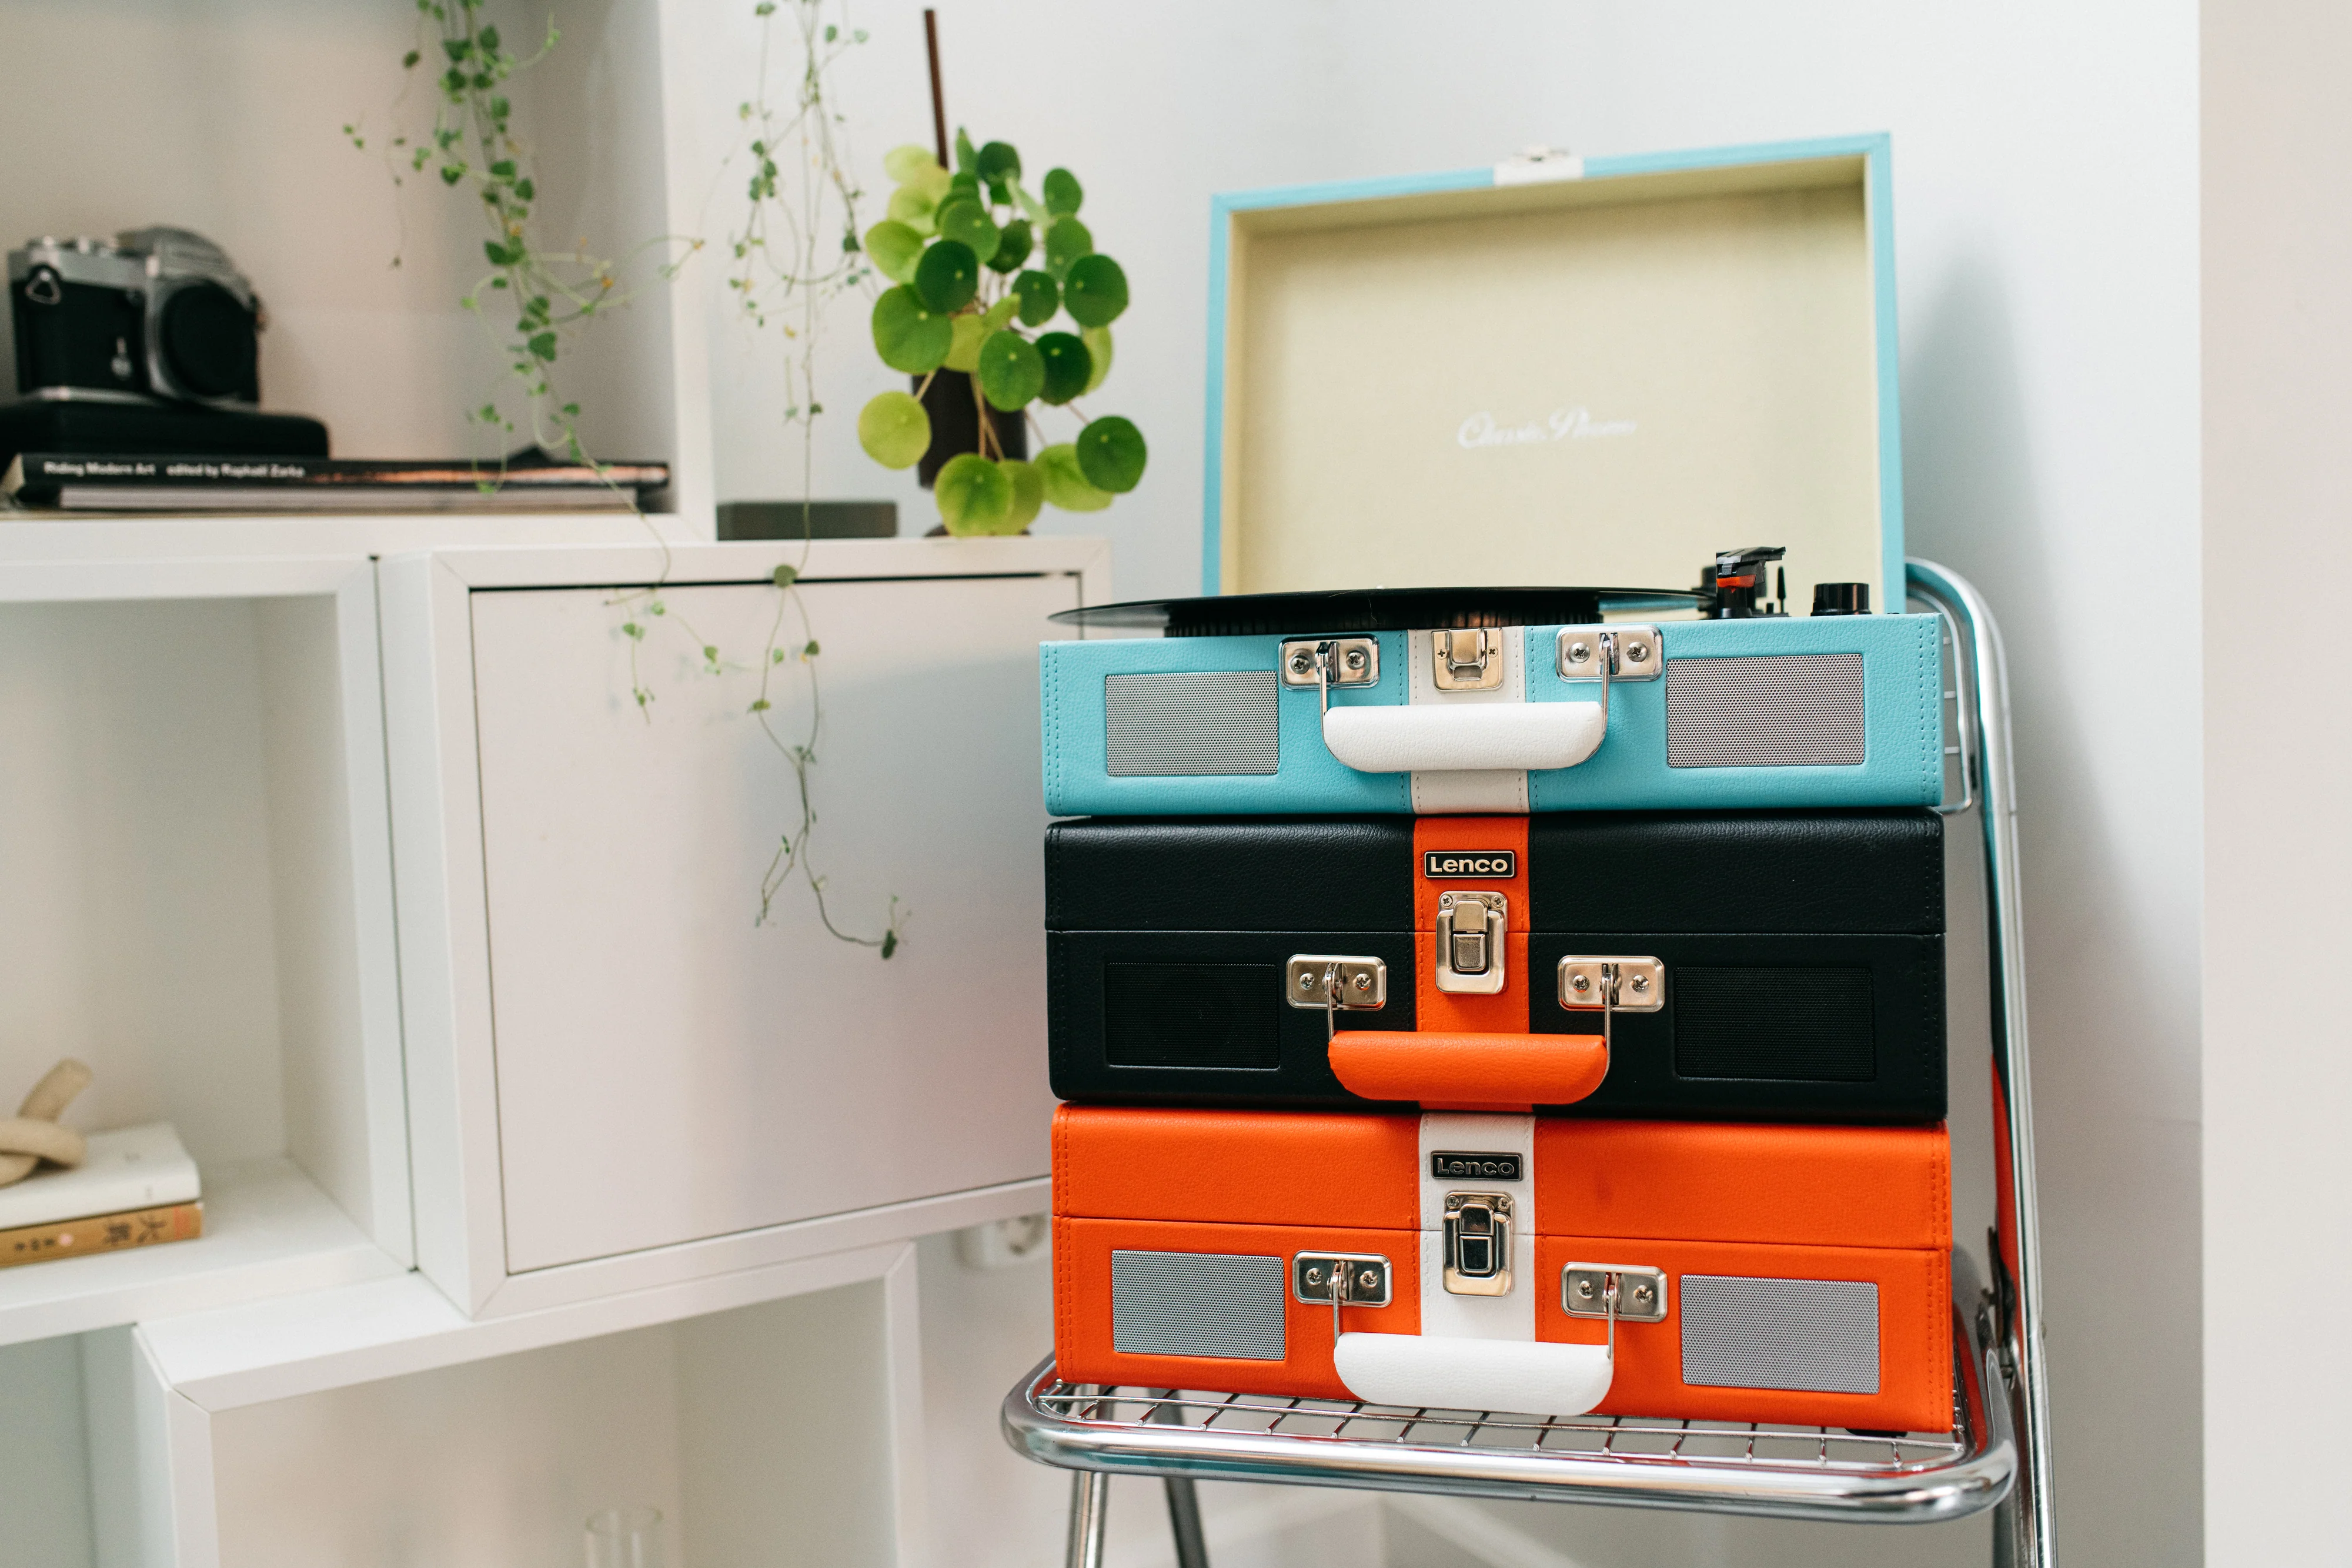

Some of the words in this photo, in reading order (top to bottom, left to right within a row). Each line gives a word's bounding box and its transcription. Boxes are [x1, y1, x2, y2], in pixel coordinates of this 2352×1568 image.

[44, 462, 84, 477] Riding
[86, 462, 133, 476] Modern
[135, 463, 156, 476] Art
[166, 463, 203, 476] edited
[205, 463, 220, 479] by
[1431, 857, 1508, 873] Lenco
[1437, 1158, 1515, 1176] Lenco
